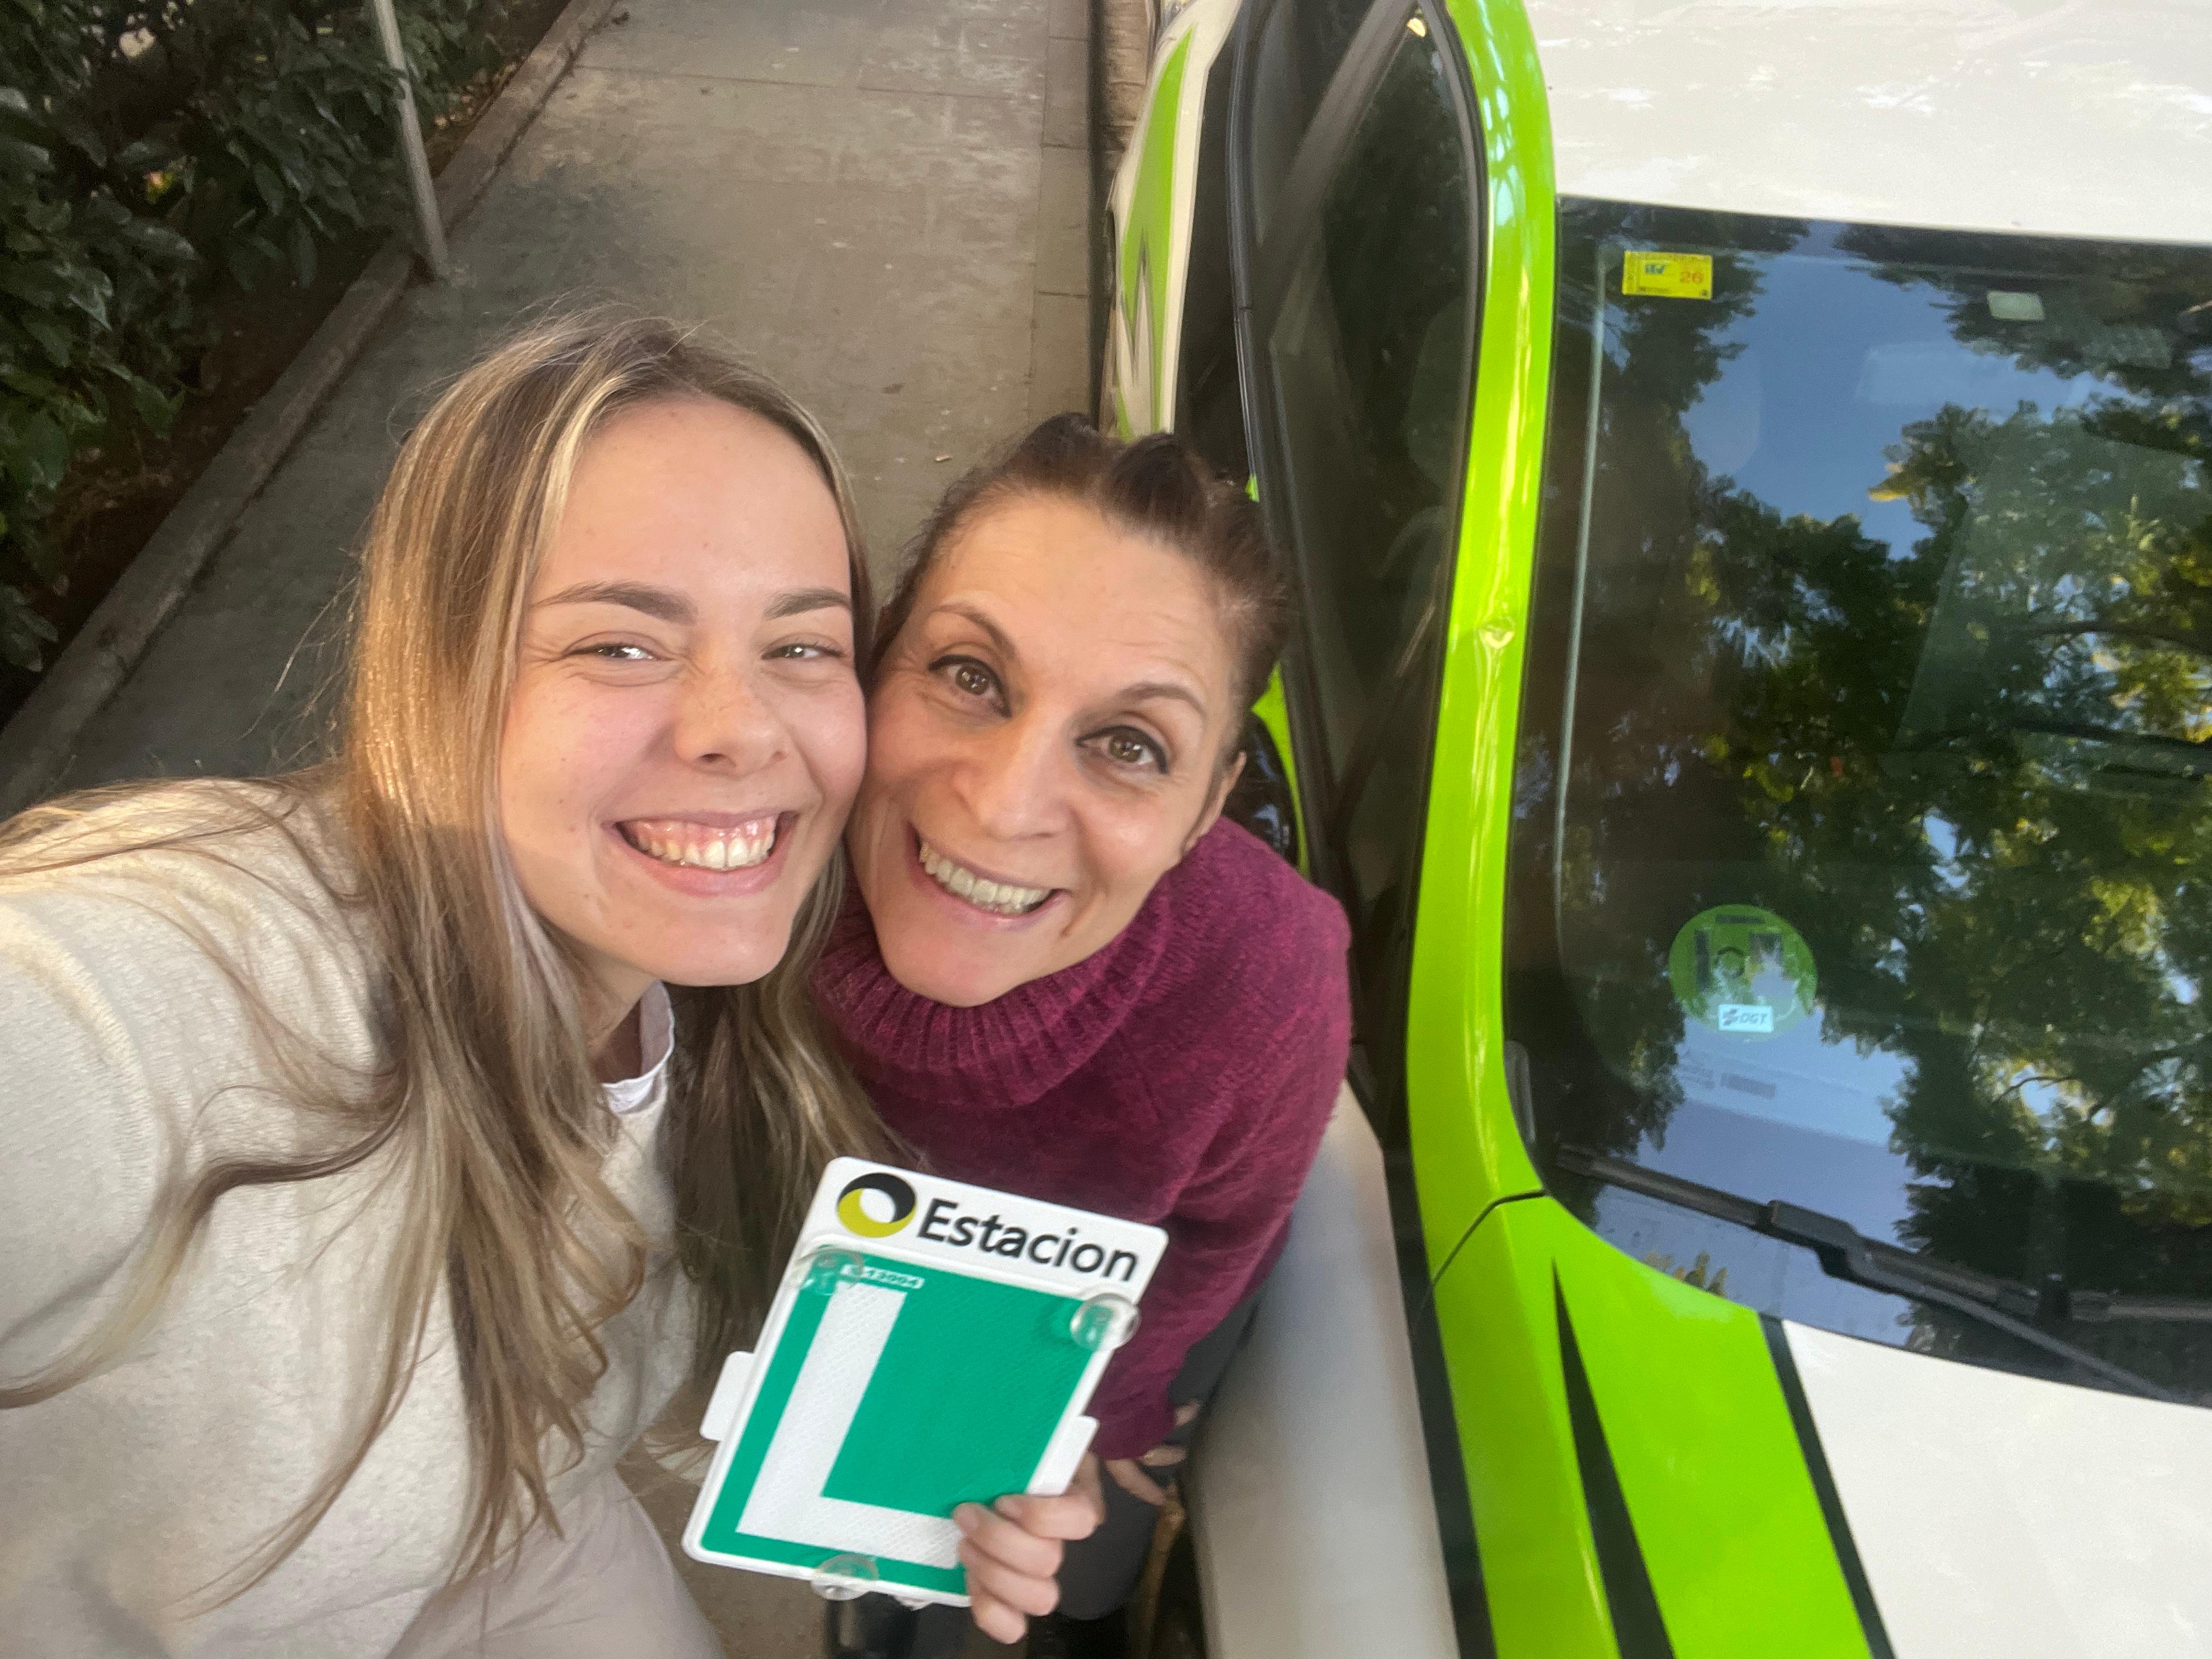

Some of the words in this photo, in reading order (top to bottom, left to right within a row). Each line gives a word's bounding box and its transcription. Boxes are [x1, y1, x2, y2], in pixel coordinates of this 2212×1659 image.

[1739, 1012, 1768, 1024] DGT
[917, 1198, 1139, 1282] Estacion
[736, 1283, 959, 1570] L
